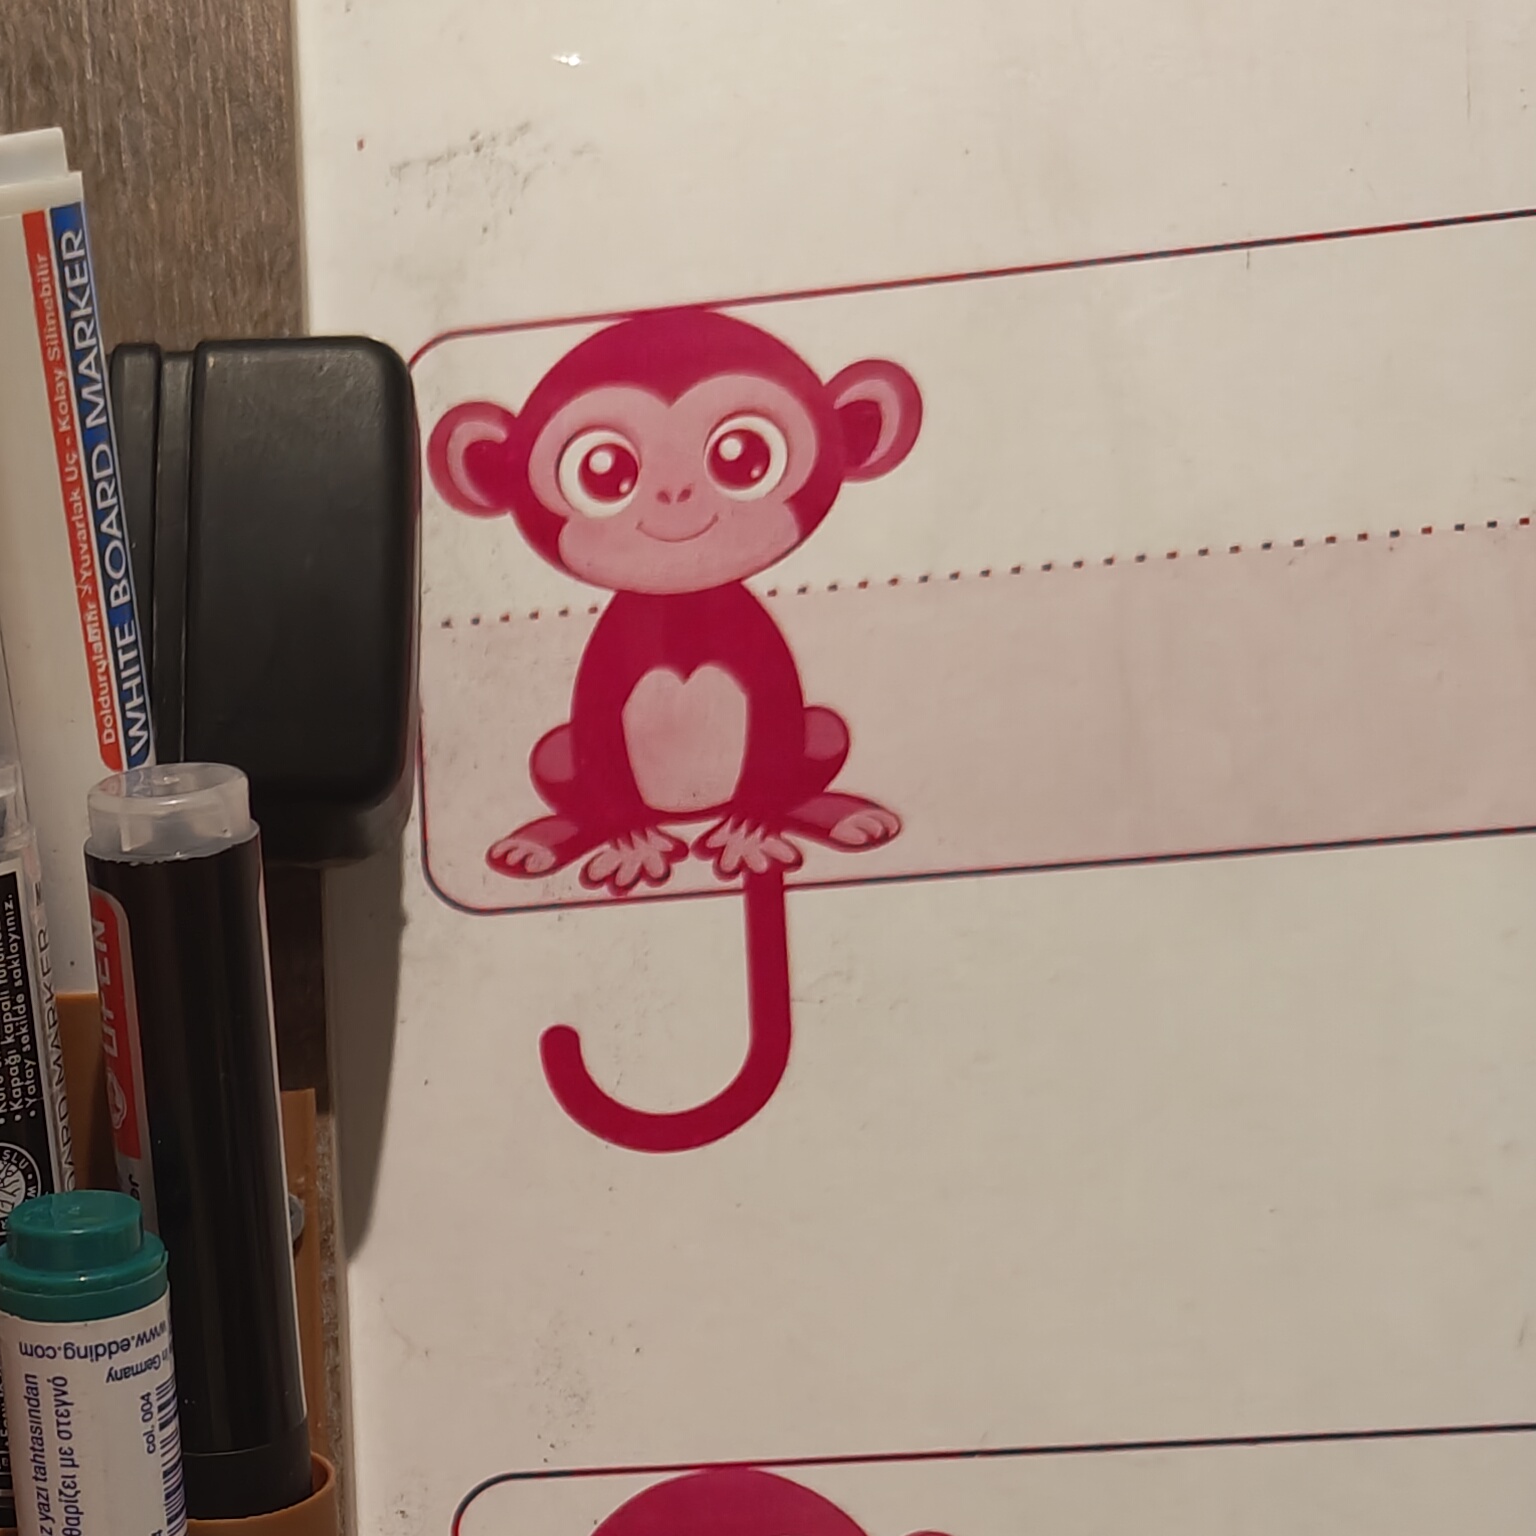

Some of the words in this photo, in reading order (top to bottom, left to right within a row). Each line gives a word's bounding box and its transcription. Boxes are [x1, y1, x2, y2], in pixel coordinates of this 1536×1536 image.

[33, 250, 64, 361] Silinebilir
[55, 227, 111, 428] MARKER
[50, 367, 74, 431] Kolay
[60, 452, 82, 482] Uç
[67, 487, 93, 582] Yuvarlak
[88, 442, 133, 607] BOARD
[113, 619, 152, 755] WHITE
[0, 893, 24, 987] saklayınız.
[1, 1048, 24, 1111] Kapağı
[21, 1055, 39, 1107] Yatay
[19, 1320, 167, 1363] www.edding.com
[106, 1354, 161, 1383] Germany
[21, 1372, 47, 1483] tahtasından
[47, 1373, 76, 1441] στεγνό
[137, 1391, 154, 1422] 004
[140, 1424, 157, 1454] col.
[34, 1485, 55, 1524] yazı
